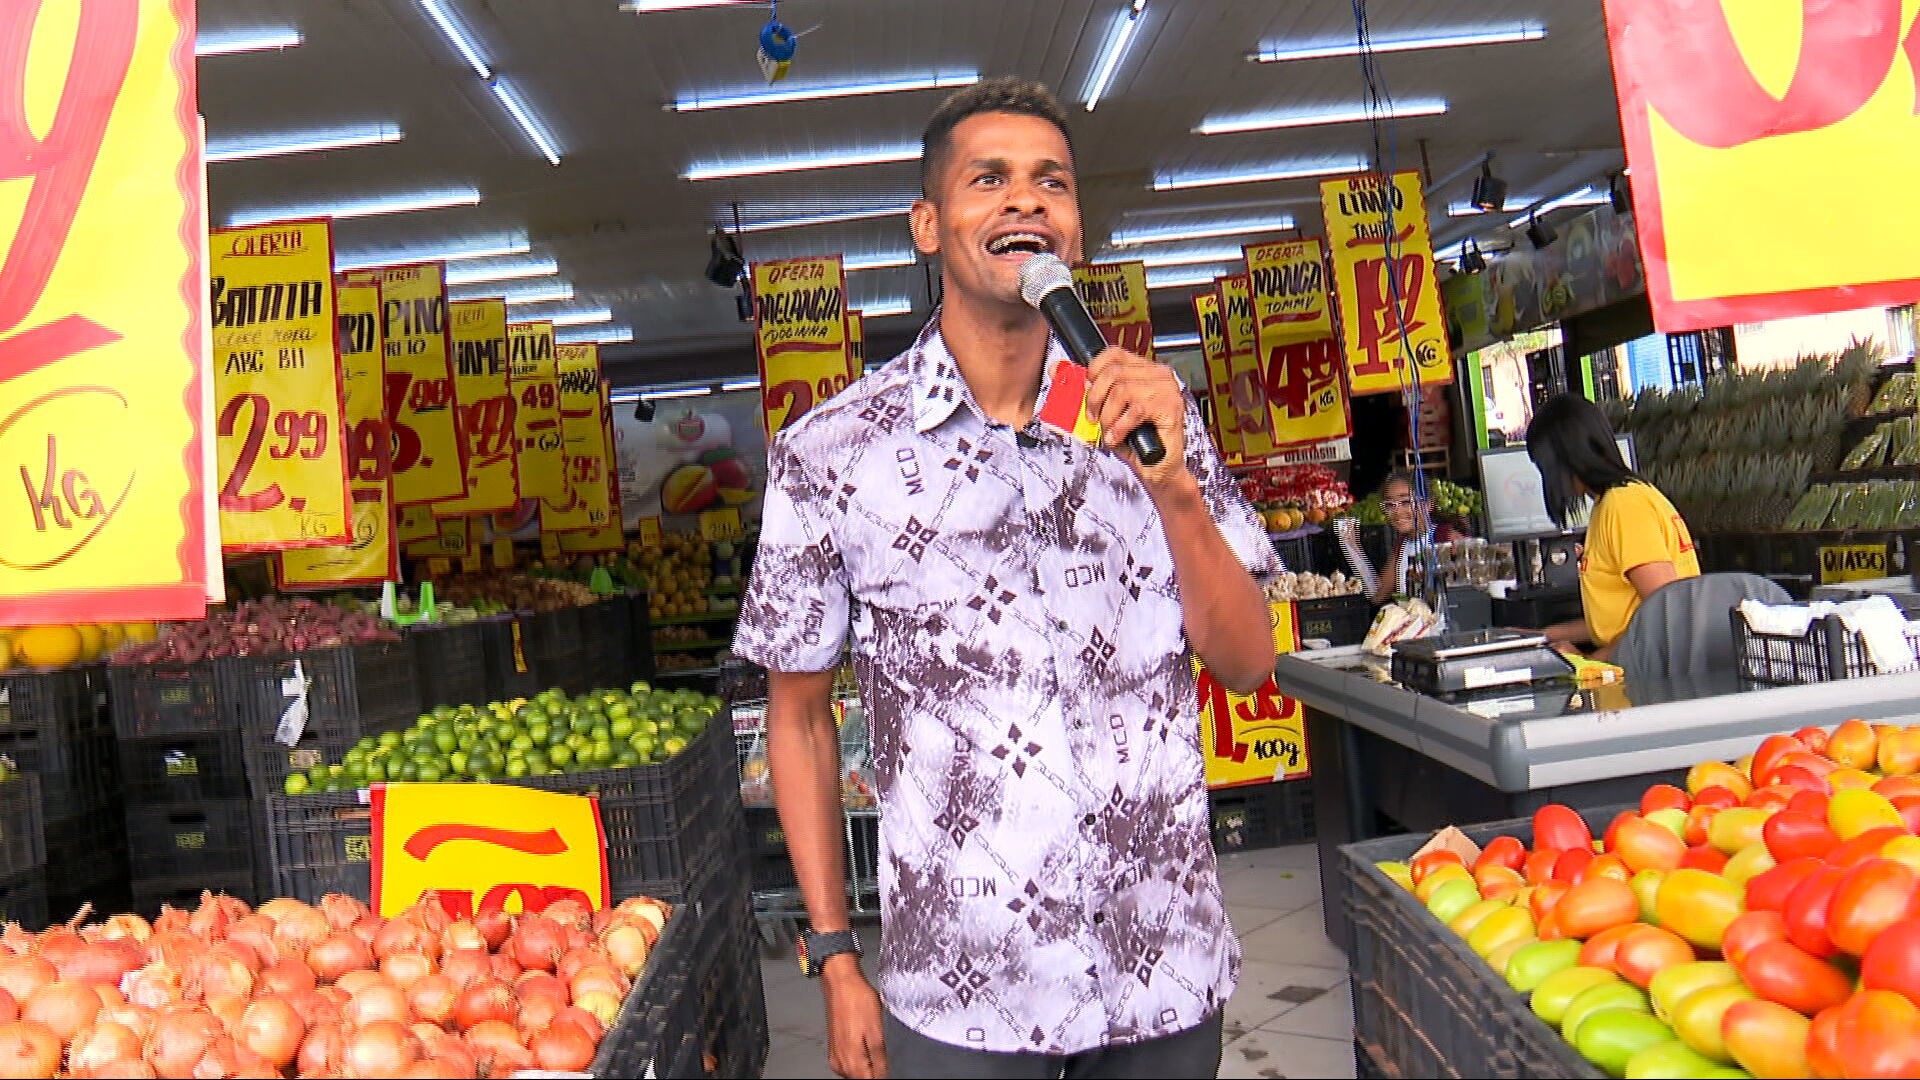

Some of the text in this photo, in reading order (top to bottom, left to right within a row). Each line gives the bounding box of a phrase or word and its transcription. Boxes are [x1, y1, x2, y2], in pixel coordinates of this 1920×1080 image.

[1256, 245, 1305, 262] OFERTA
[768, 263, 826, 285] OFERTA
[1252, 262, 1322, 299] MANGA
[757, 285, 842, 328] MELANCIA
[1265, 297, 1315, 314] TOMMY
[1319, 391, 1335, 407] KG
[218, 393, 328, 514] 2.99
[21, 434, 105, 530] KG
[896, 447, 924, 497] MCD
[1064, 561, 1105, 589] MCD
[1110, 714, 1132, 764] MCD
[951, 876, 997, 898] MCD
